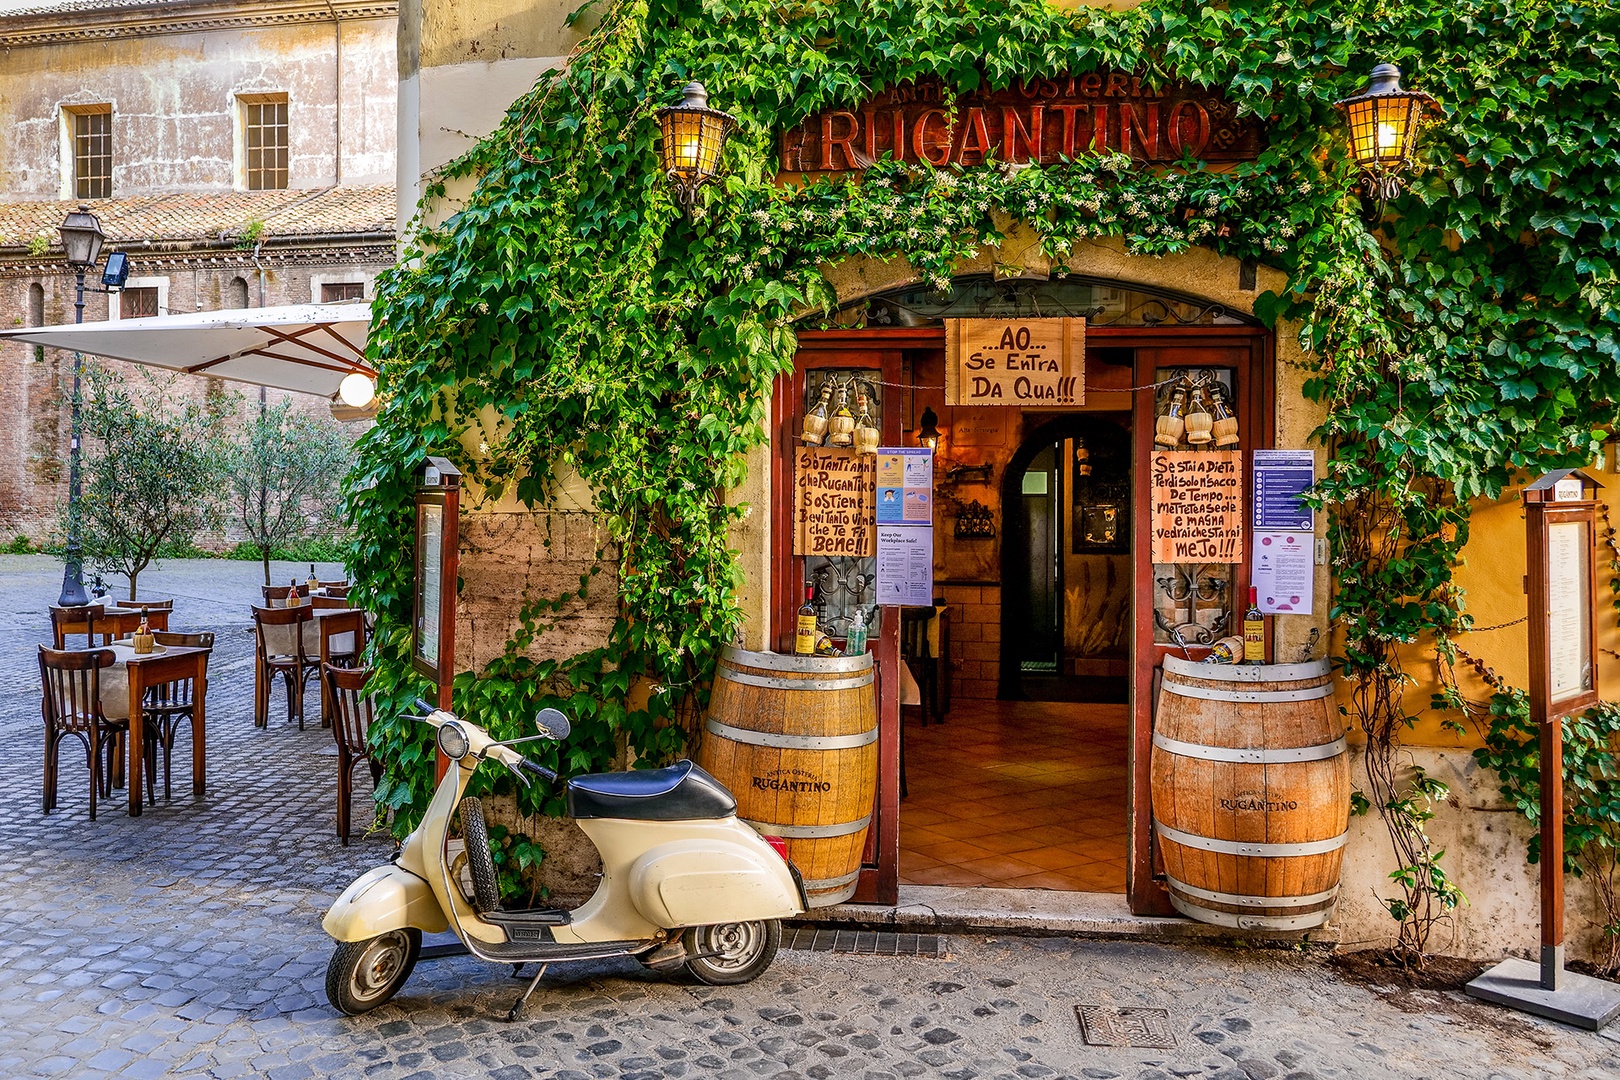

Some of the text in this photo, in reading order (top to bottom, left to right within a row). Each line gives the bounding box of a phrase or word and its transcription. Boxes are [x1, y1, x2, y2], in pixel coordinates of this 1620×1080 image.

[819, 101, 1211, 171] RUGANTINO
[982, 326, 1047, 351] ...AO...
[965, 353, 996, 370] Se
[1154, 456, 1175, 473] Se
[1197, 461, 1205, 472] A
[1154, 473, 1178, 488] Perdi
[1178, 475, 1199, 487] Solo
[1170, 489, 1186, 500] De
[799, 509, 824, 523] Bevi
[1174, 515, 1183, 527] e
[809, 523, 830, 535] che
[832, 525, 846, 536] Te
[1191, 526, 1207, 536] che
[766, 768, 818, 782] ANTICA OSTERIA
[752, 776, 831, 793] RUGANTINO
[1220, 799, 1298, 812] RUGANTINO
